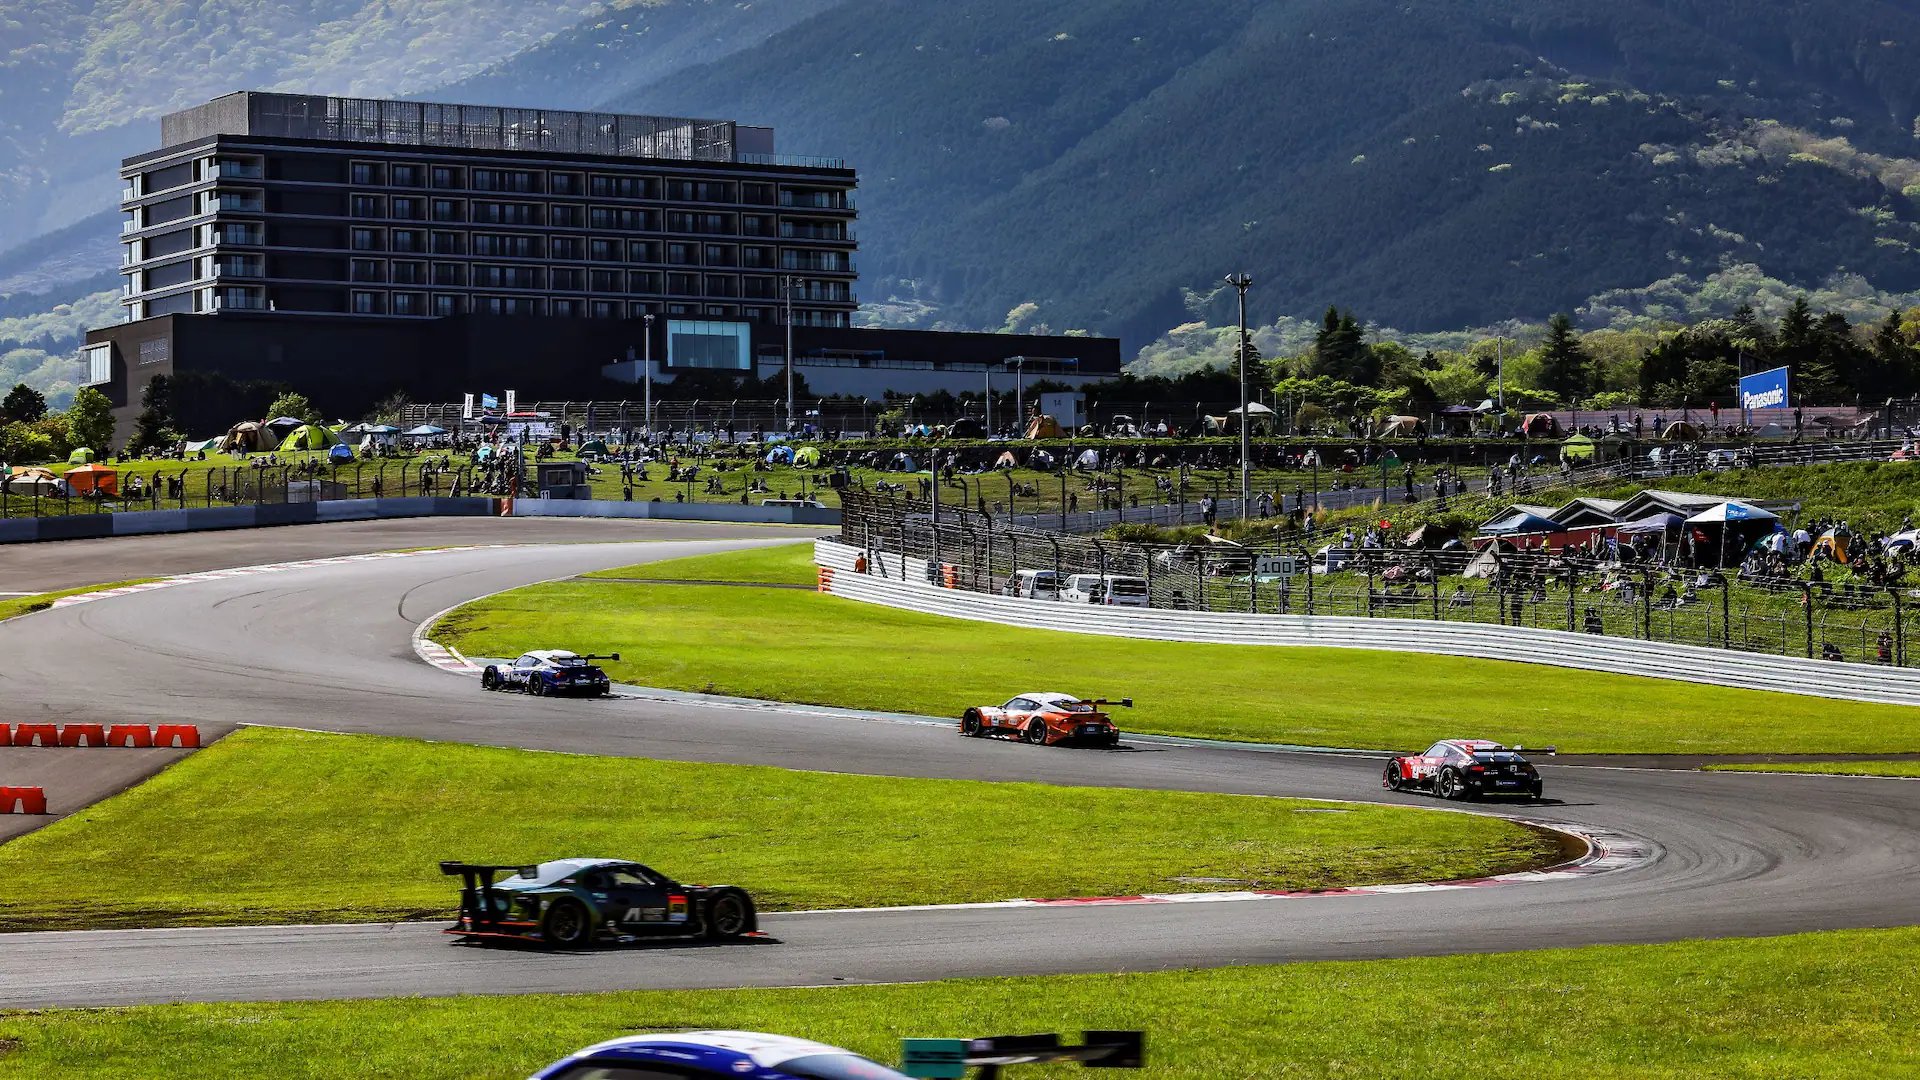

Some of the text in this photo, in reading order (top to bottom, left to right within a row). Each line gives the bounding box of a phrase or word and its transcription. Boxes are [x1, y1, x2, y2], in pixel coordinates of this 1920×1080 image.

[1743, 384, 1783, 409] Panasonic
[1054, 399, 1062, 407] 14
[541, 491, 549, 499] 11
[1261, 561, 1291, 573] 100
